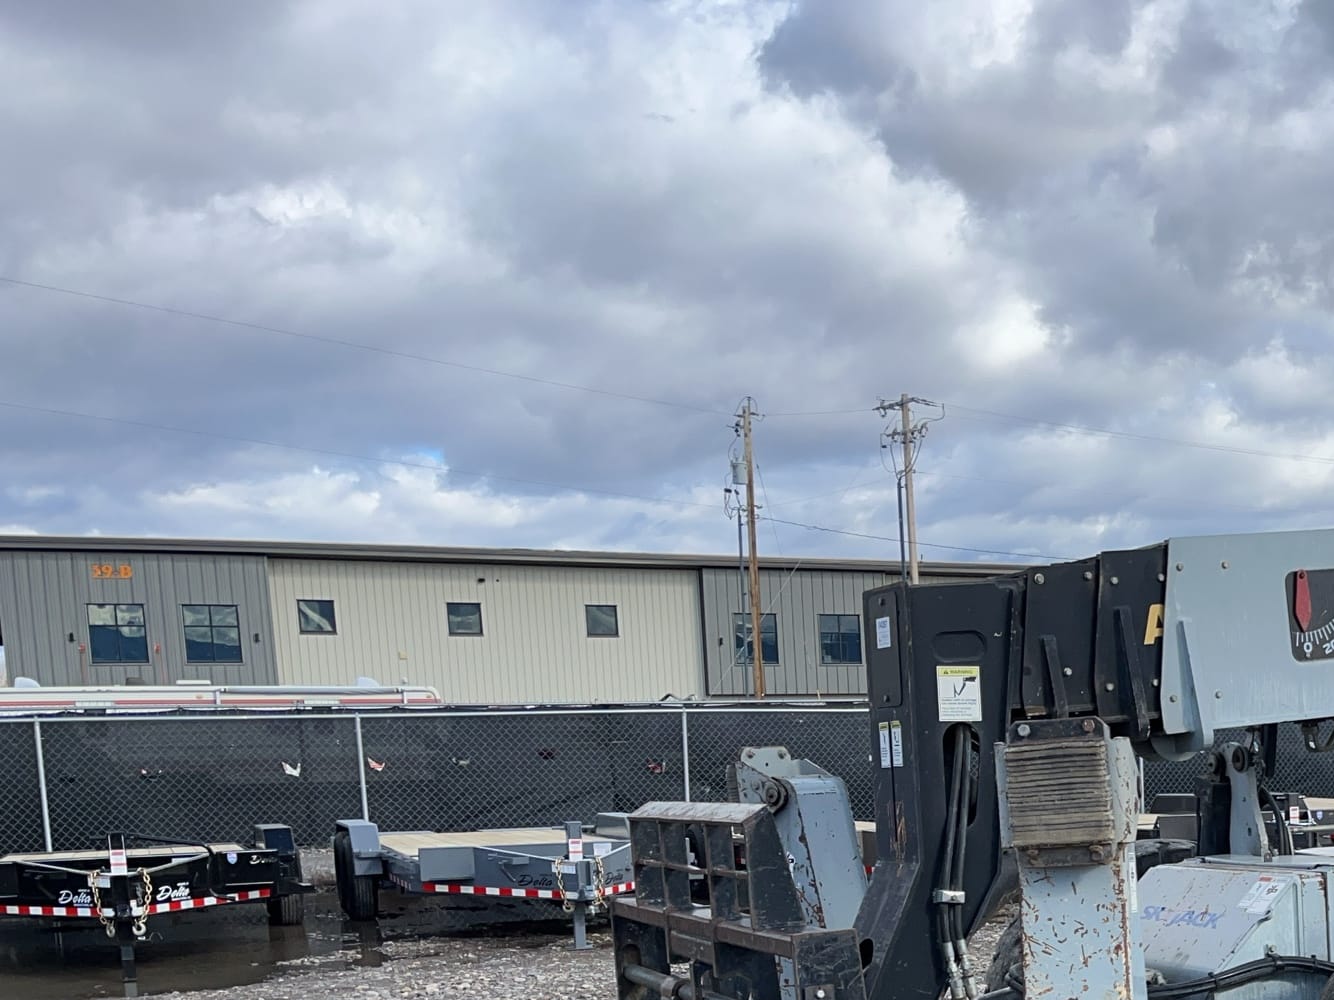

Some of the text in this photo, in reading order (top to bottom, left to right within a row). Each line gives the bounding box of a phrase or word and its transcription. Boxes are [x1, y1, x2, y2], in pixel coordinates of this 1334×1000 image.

[1303, 641, 1313, 653] 0
[518, 874, 553, 887] Delta
[59, 890, 91, 904] Delta
[156, 885, 191, 901] Delta
[1140, 904, 1225, 929] SKJACK
